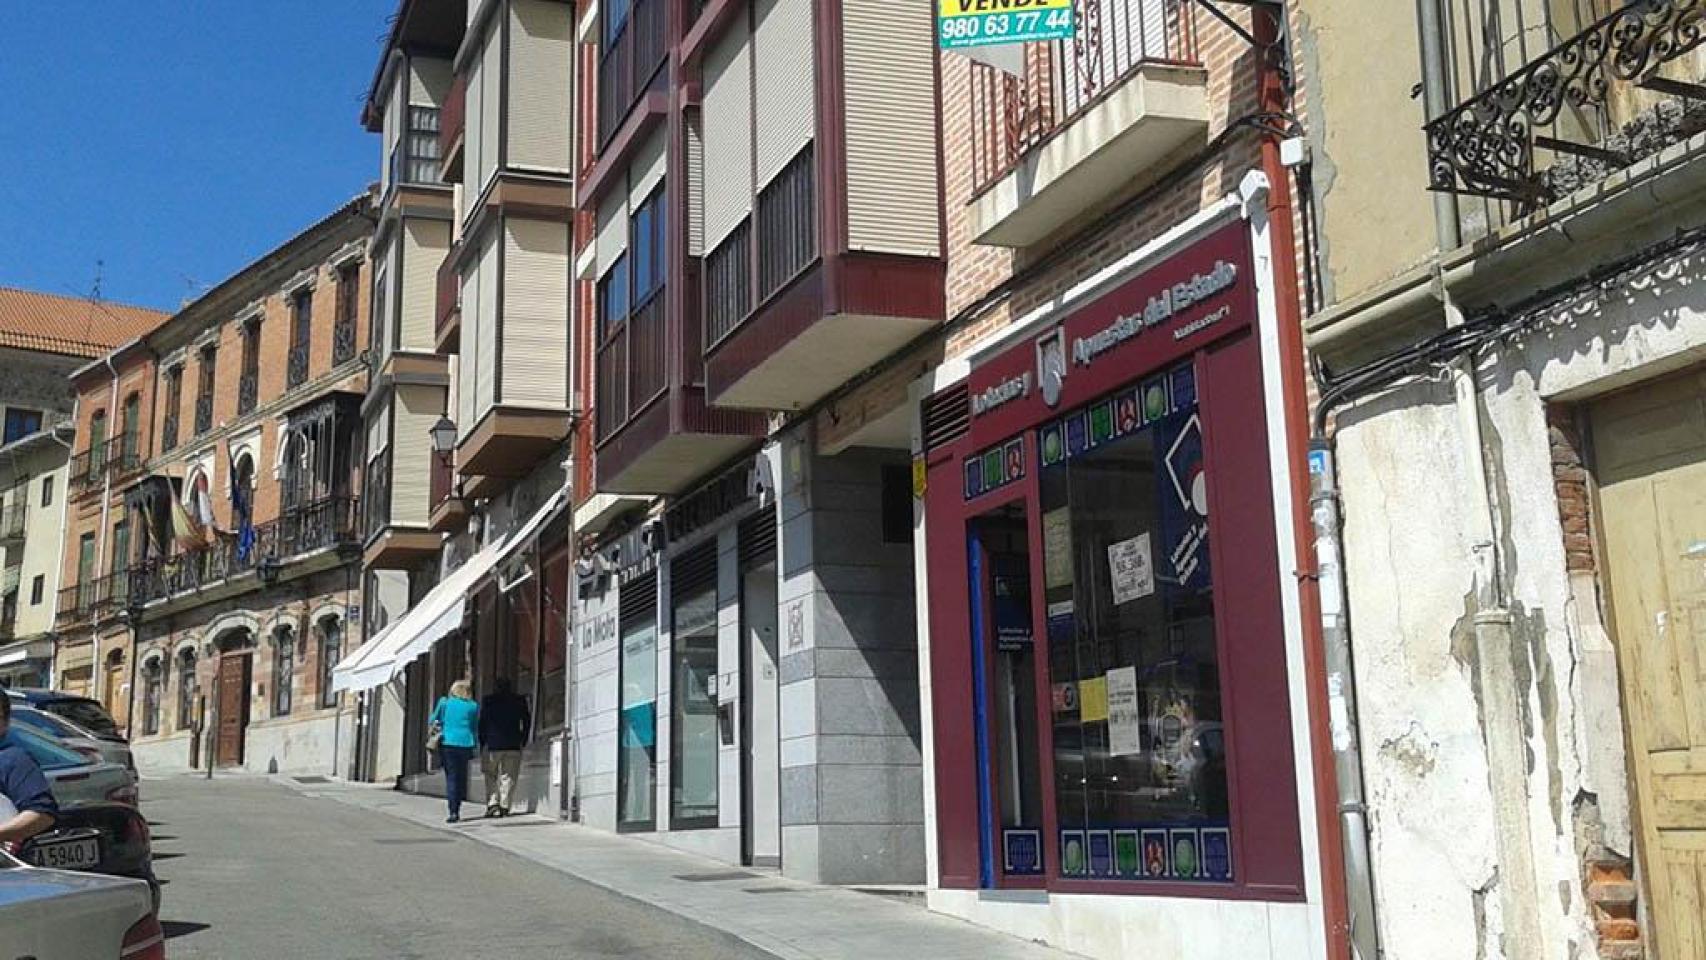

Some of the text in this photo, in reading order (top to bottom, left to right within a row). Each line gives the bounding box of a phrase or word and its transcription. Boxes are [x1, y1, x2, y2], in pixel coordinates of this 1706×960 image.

[958, 0, 1048, 12] VEN
[942, 17, 979, 39] 980
[984, 14, 1009, 35] 63
[1016, 12, 1040, 32] 77
[1046, 9, 1071, 29] 44
[1022, 371, 1032, 397] y
[1072, 313, 1144, 364] Apuestas
[1143, 289, 1172, 326] del
[1171, 260, 1238, 312] Estado
[48, 844, 84, 866] 5940
[89, 842, 97, 862] J
